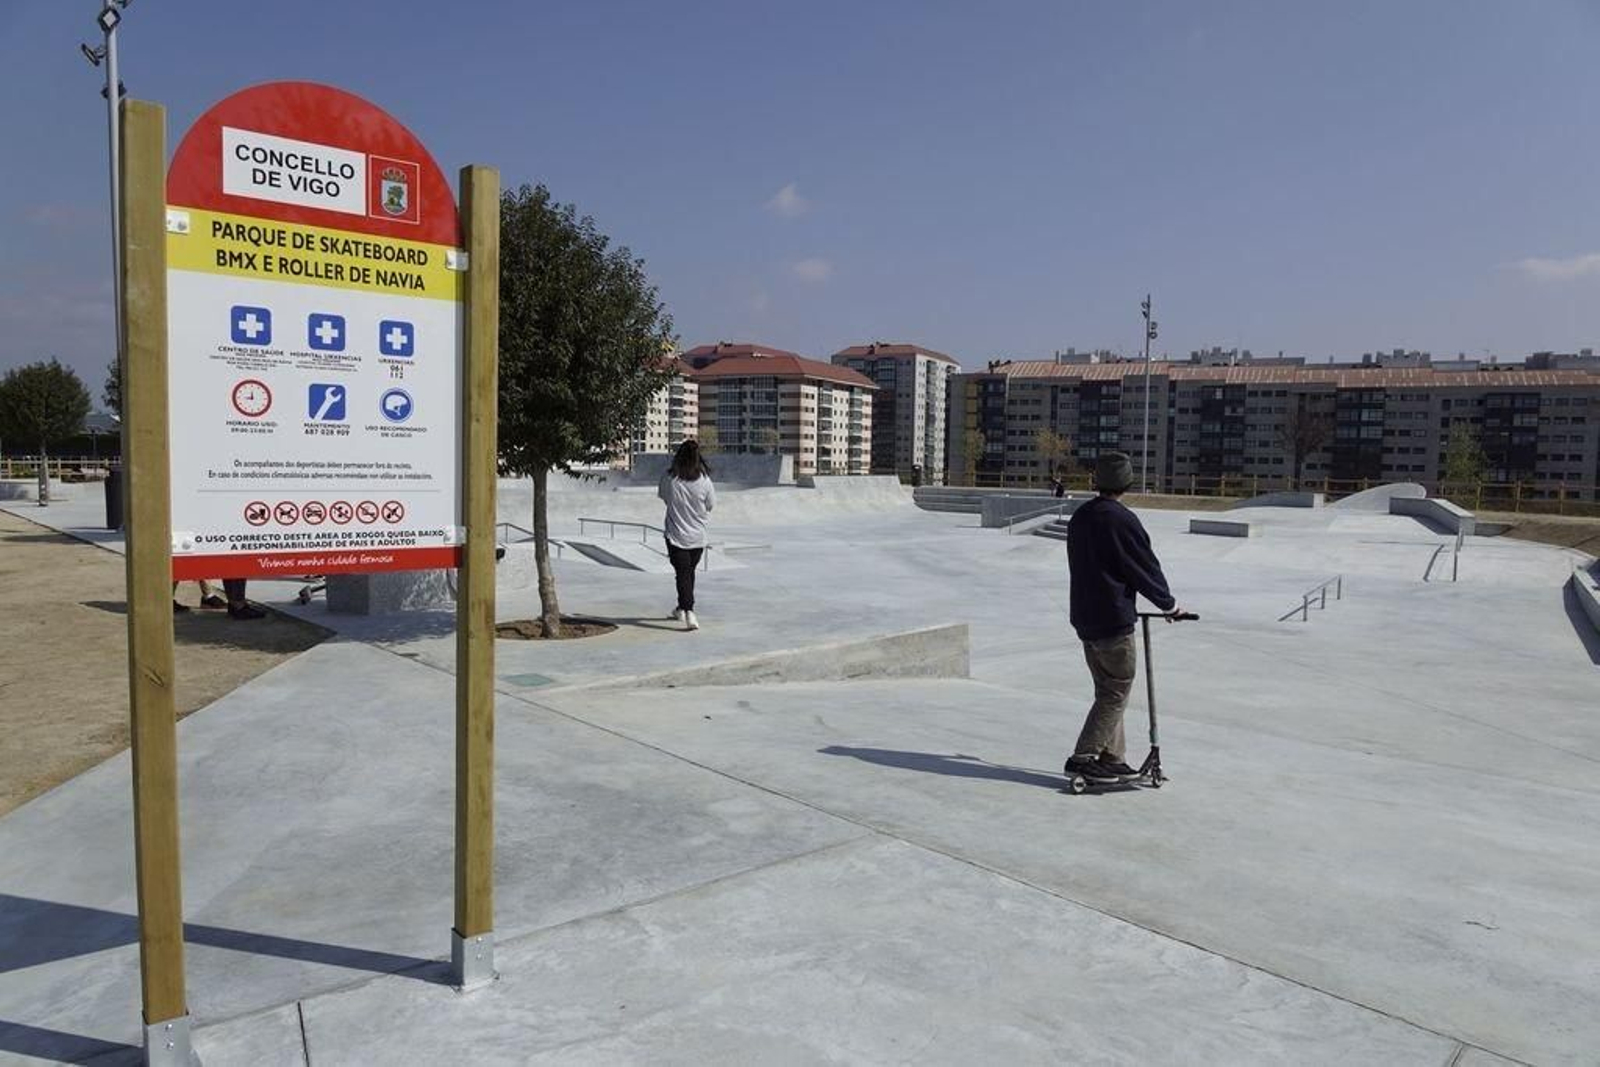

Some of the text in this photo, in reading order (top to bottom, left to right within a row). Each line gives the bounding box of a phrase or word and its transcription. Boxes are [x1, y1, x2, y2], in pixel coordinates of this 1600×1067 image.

[235, 144, 355, 180] CONCELLO
[252, 168, 341, 198] DE VIGO
[211, 220, 428, 266] PARQUE DE SKATEBOARD
[215, 249, 426, 291] BMX E ROLLER DE NAVIA
[217, 346, 248, 354] CENTRO
[290, 351, 322, 360] HOSPITAL
[229, 534, 281, 542] CORRECTO
[284, 532, 312, 540] DESTE
[356, 530, 384, 538] XOGOS
[240, 541, 332, 550] RESPONSABILIDADE
[378, 538, 416, 546] ADULTOS
[327, 554, 357, 565] cidade
[360, 553, 393, 564] fermosa
